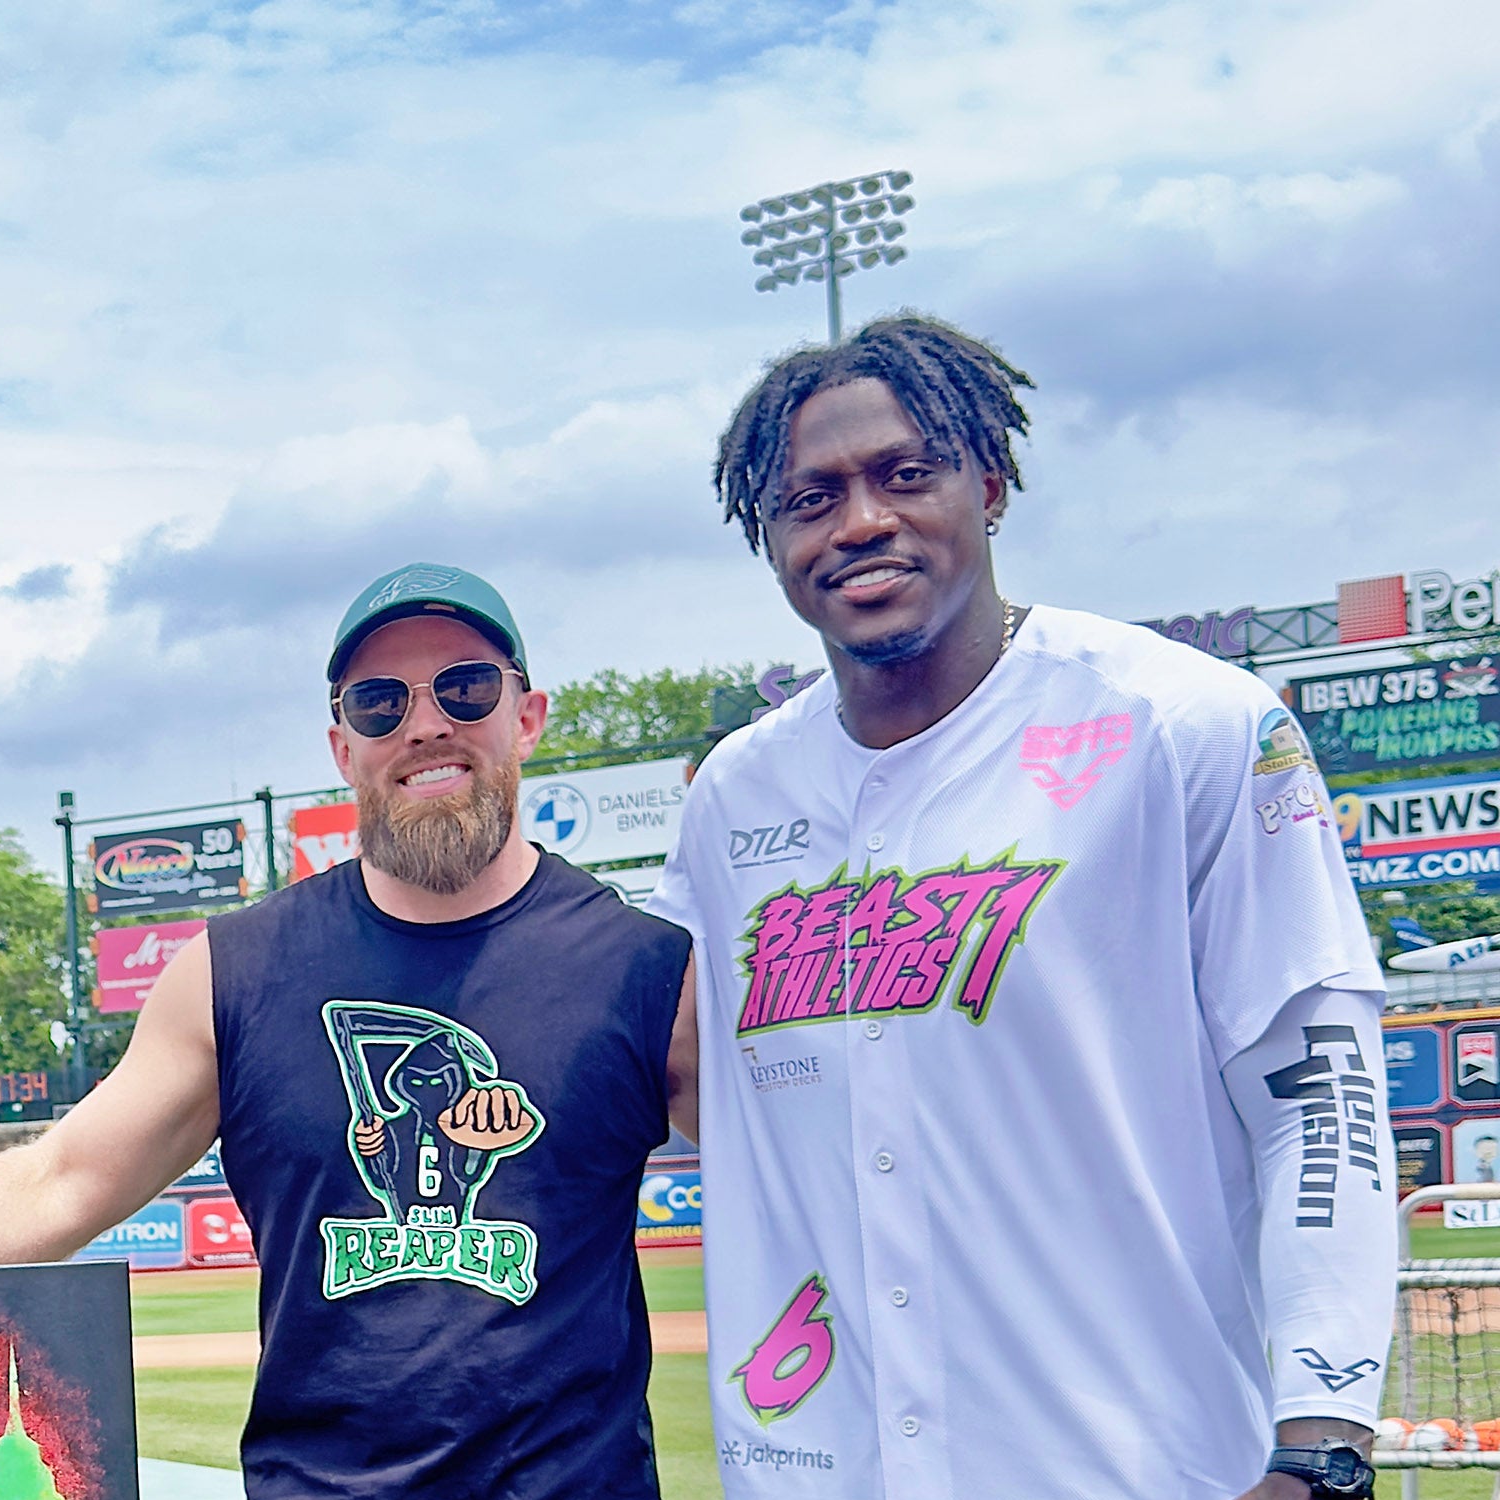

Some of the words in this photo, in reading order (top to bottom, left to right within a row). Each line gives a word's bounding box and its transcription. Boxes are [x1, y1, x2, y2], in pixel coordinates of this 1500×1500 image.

[1301, 675, 1380, 713] IBEW
[1382, 668, 1438, 703] 375
[598, 785, 683, 814] DANIELS
[1369, 789, 1499, 838] NEWS
[202, 828, 233, 853] 50
[616, 812, 666, 832] BMW
[729, 818, 809, 860] DTLR
[738, 939, 960, 1032] ATHLETICS
[749, 1056, 820, 1084] KEYSTONE
[419, 1146, 440, 1197] 6
[409, 1206, 454, 1226] SLIM
[330, 1227, 528, 1293] REAPER
[727, 1272, 835, 1425] 6
[742, 1442, 834, 1471] jakprints
